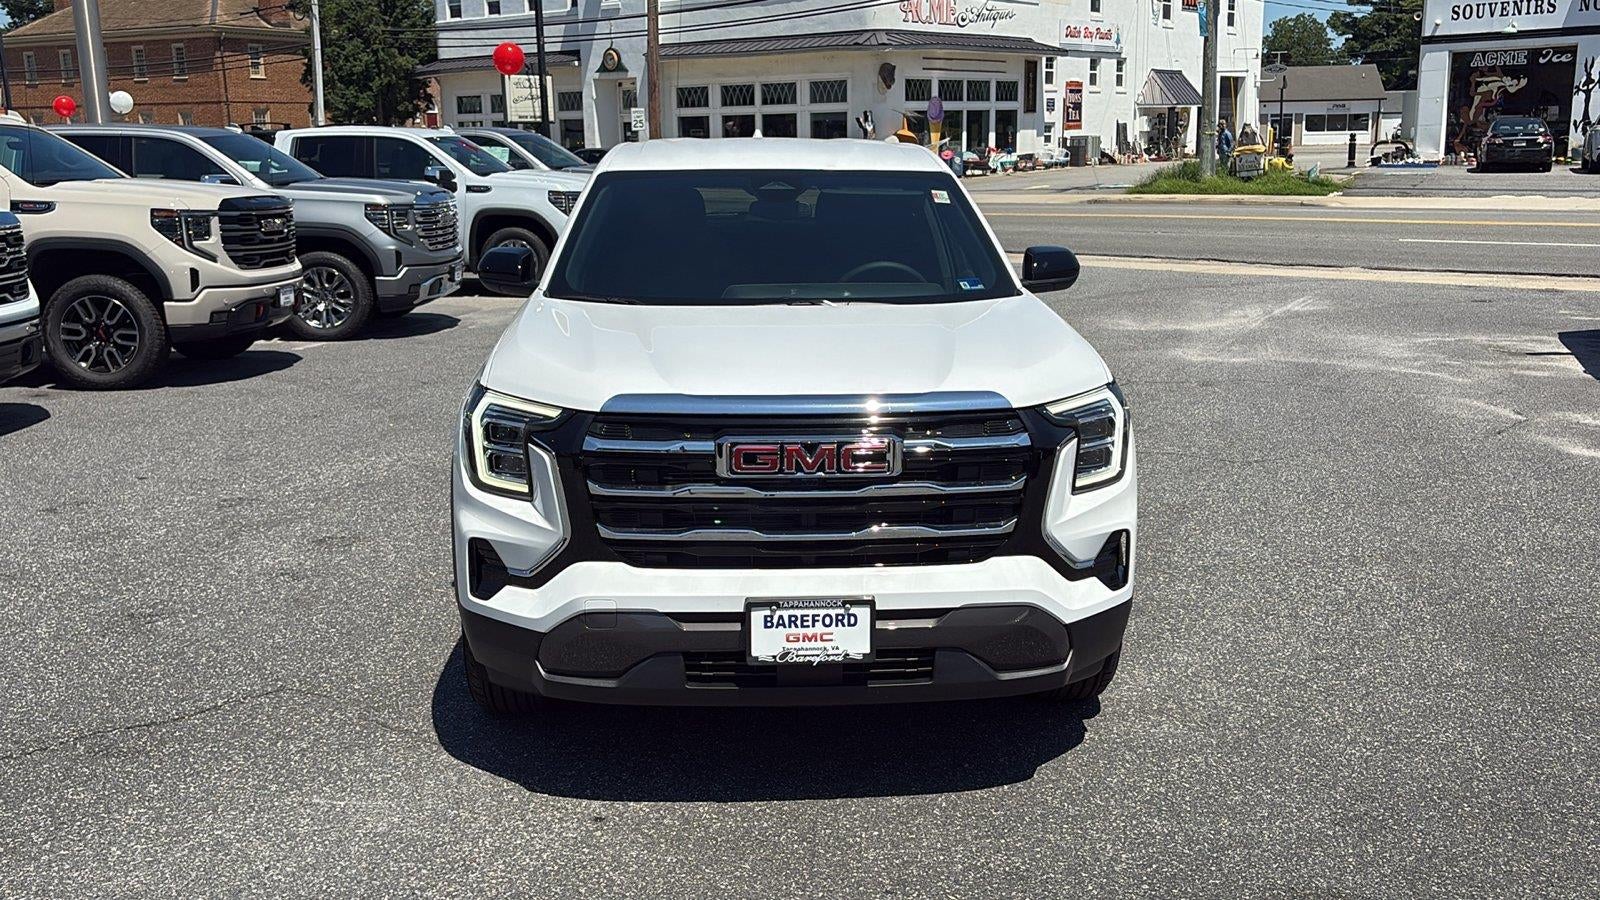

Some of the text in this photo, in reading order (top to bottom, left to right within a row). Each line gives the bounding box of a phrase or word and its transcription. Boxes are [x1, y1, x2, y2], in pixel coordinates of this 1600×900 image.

[900, 0, 957, 26] ACME
[1451, 0, 1557, 21] SOUVENIRS
[1065, 25, 1113, 43] Dutch Boy Paints
[1470, 48, 1574, 67] ACME Ice
[1068, 108, 1080, 120] TEA
[633, 119, 644, 129] 25
[732, 444, 889, 473] GMC
[779, 600, 843, 609] TAPPAHANNOCK
[763, 613, 858, 630] BAREFORD
[785, 632, 834, 643] GMC
[776, 650, 848, 667] Bareford
